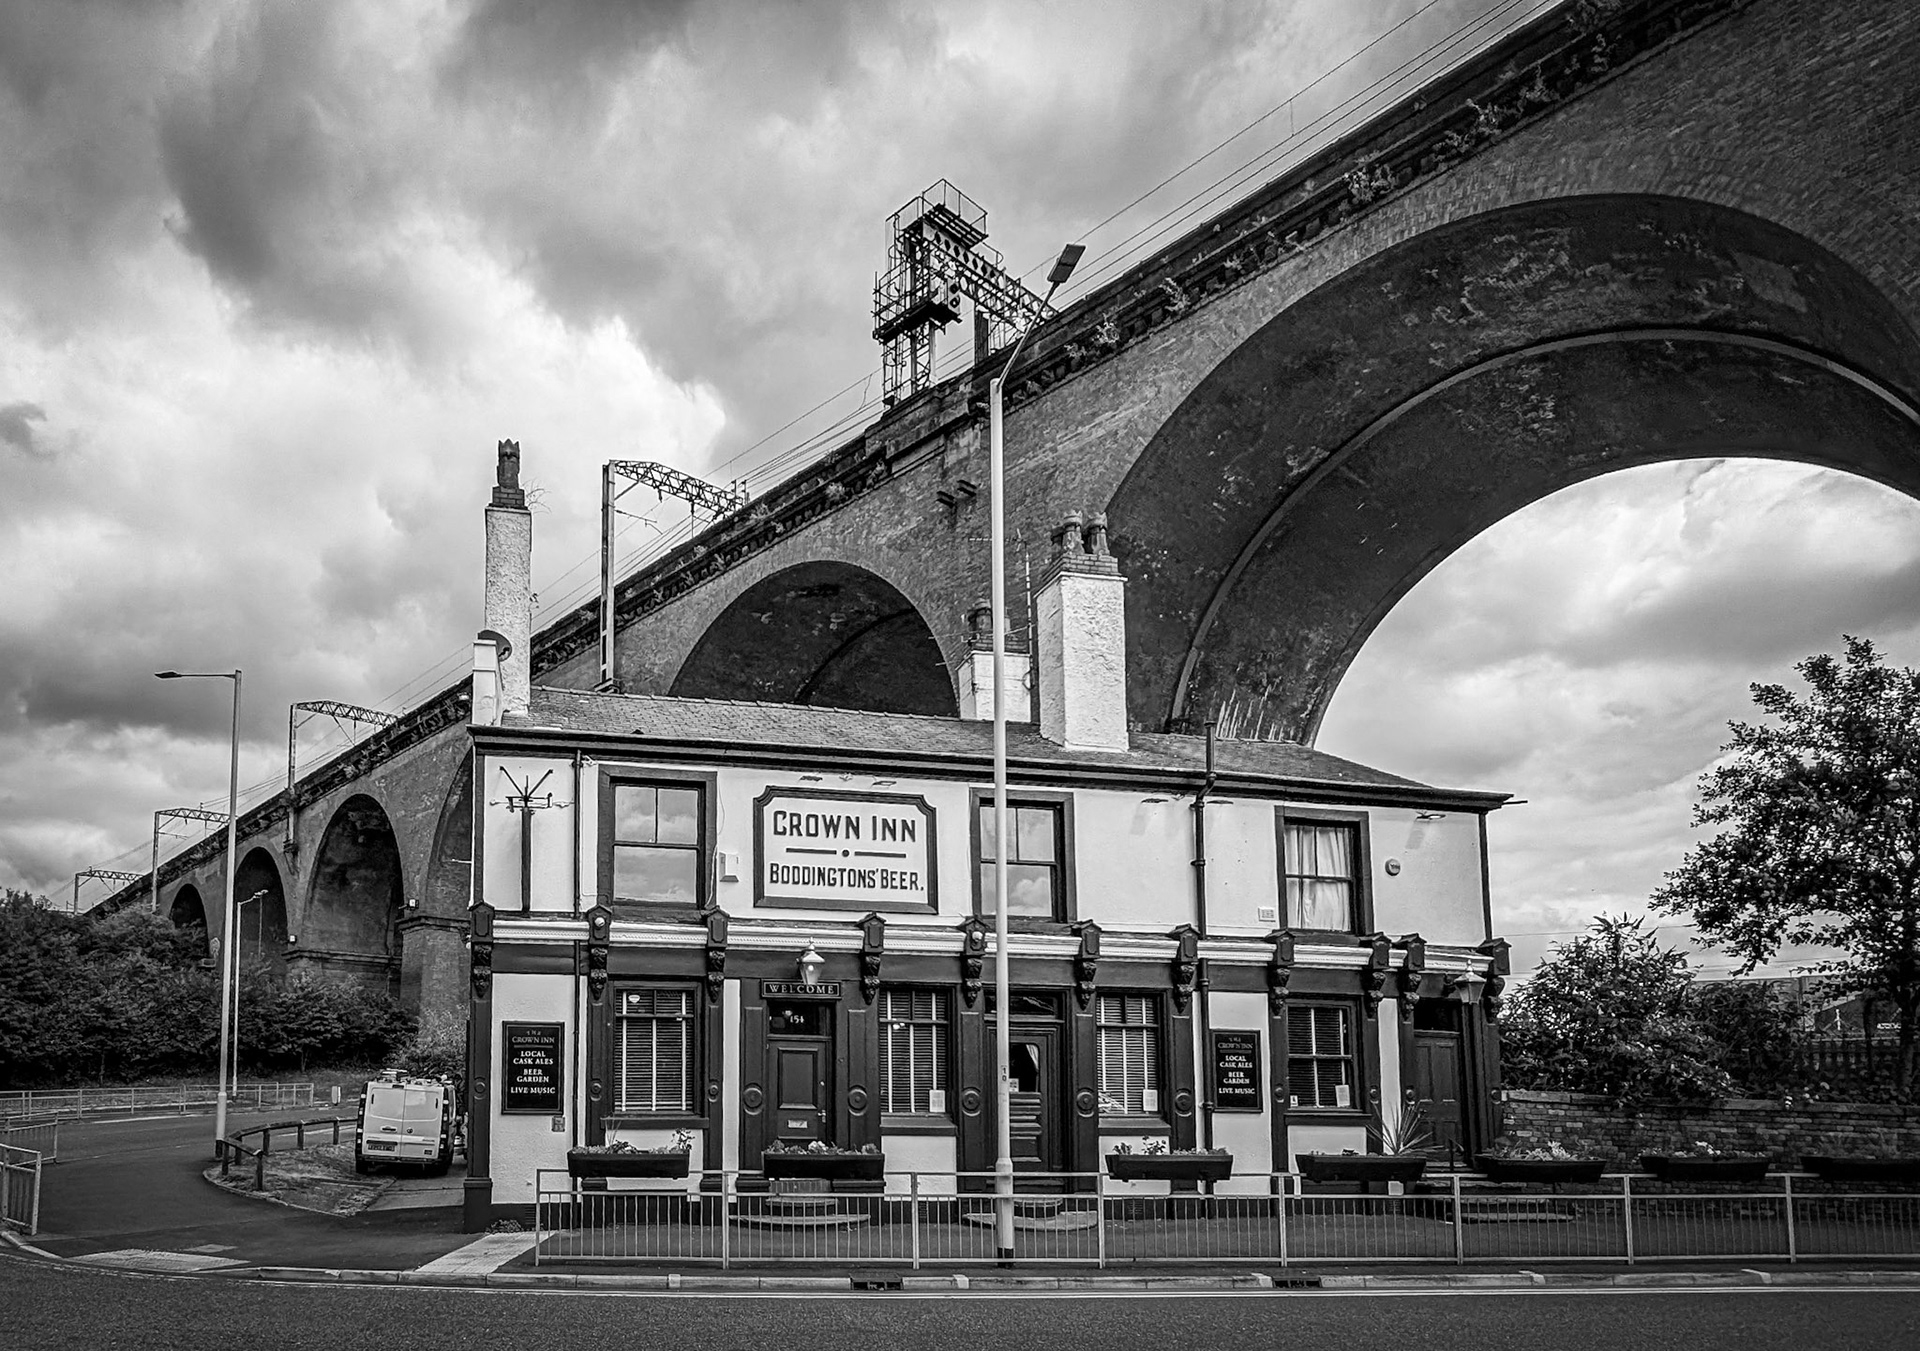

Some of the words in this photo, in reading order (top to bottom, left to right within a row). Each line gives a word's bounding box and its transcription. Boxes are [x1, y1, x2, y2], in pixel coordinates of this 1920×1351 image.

[773, 810, 860, 840] CROWN
[872, 815, 916, 843] INN
[880, 868, 924, 891] BEER.
[769, 984, 834, 994] WELCOME
